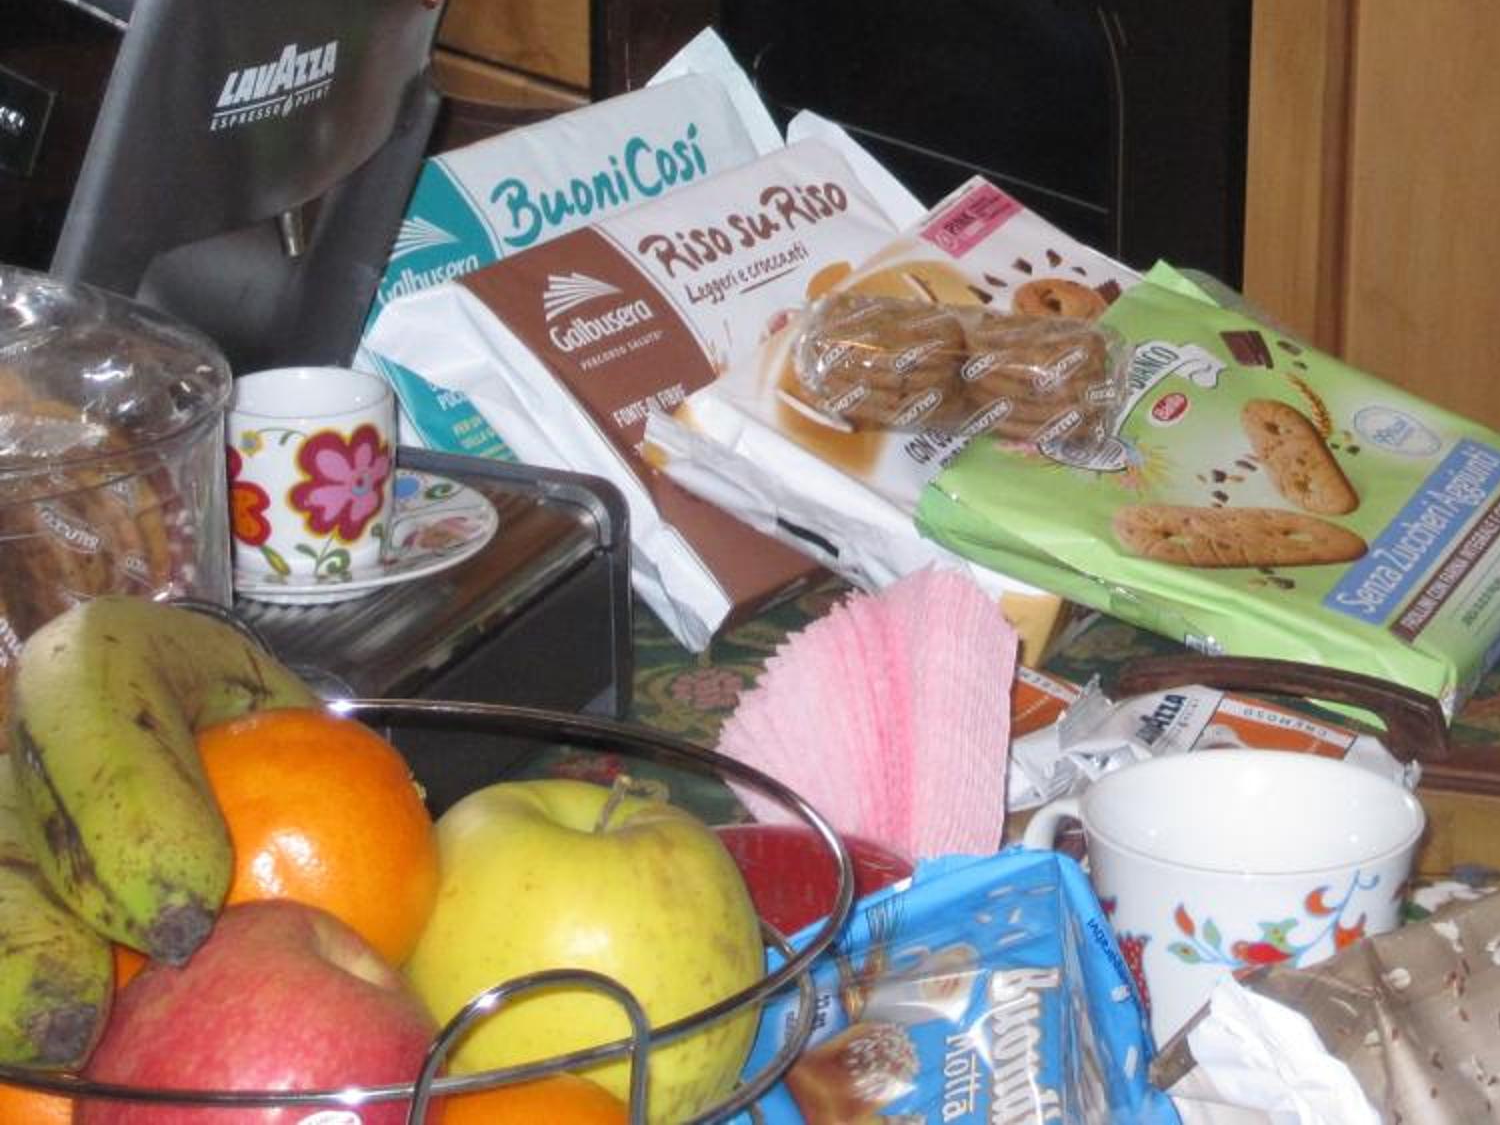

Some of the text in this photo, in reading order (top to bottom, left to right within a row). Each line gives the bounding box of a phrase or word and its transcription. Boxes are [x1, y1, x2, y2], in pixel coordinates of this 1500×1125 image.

[638, 182, 848, 278] Riso su Riso
[549, 299, 655, 353] Galbusera
[1336, 547, 1403, 613] Senza
[1373, 501, 1453, 573] Zuccheri
